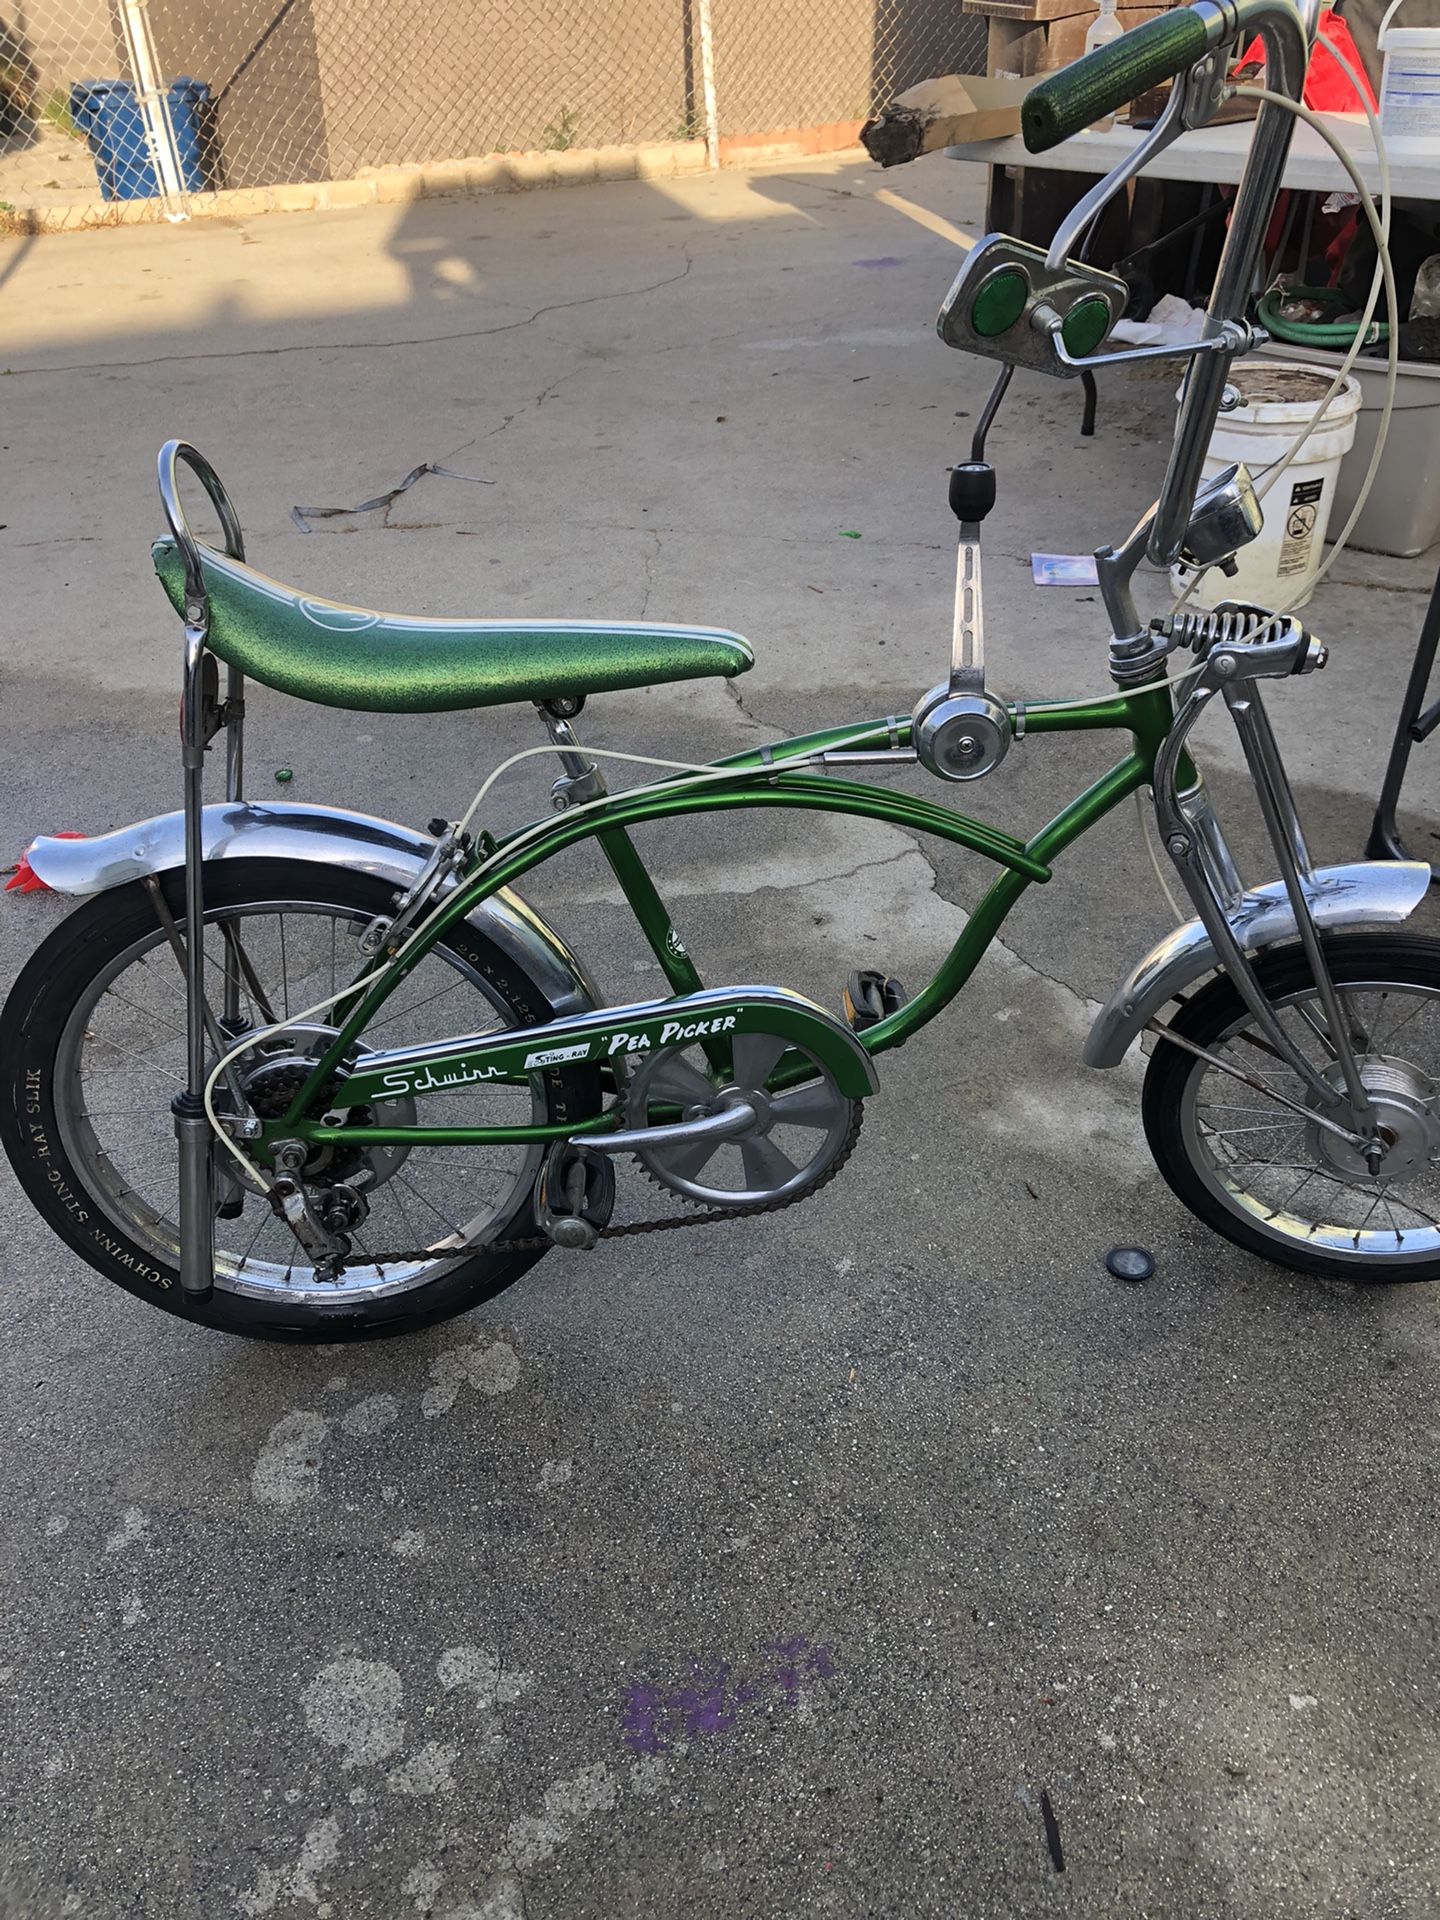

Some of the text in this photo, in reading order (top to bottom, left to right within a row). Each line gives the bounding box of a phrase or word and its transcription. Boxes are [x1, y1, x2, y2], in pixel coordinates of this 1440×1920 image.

[456, 943, 479, 962] 20
[496, 978, 536, 1024] 2.125
[26, 1068, 42, 1115] SLIK
[371, 1062, 508, 1098] Schwinn
[90, 1228, 173, 1290] SCHWINN
